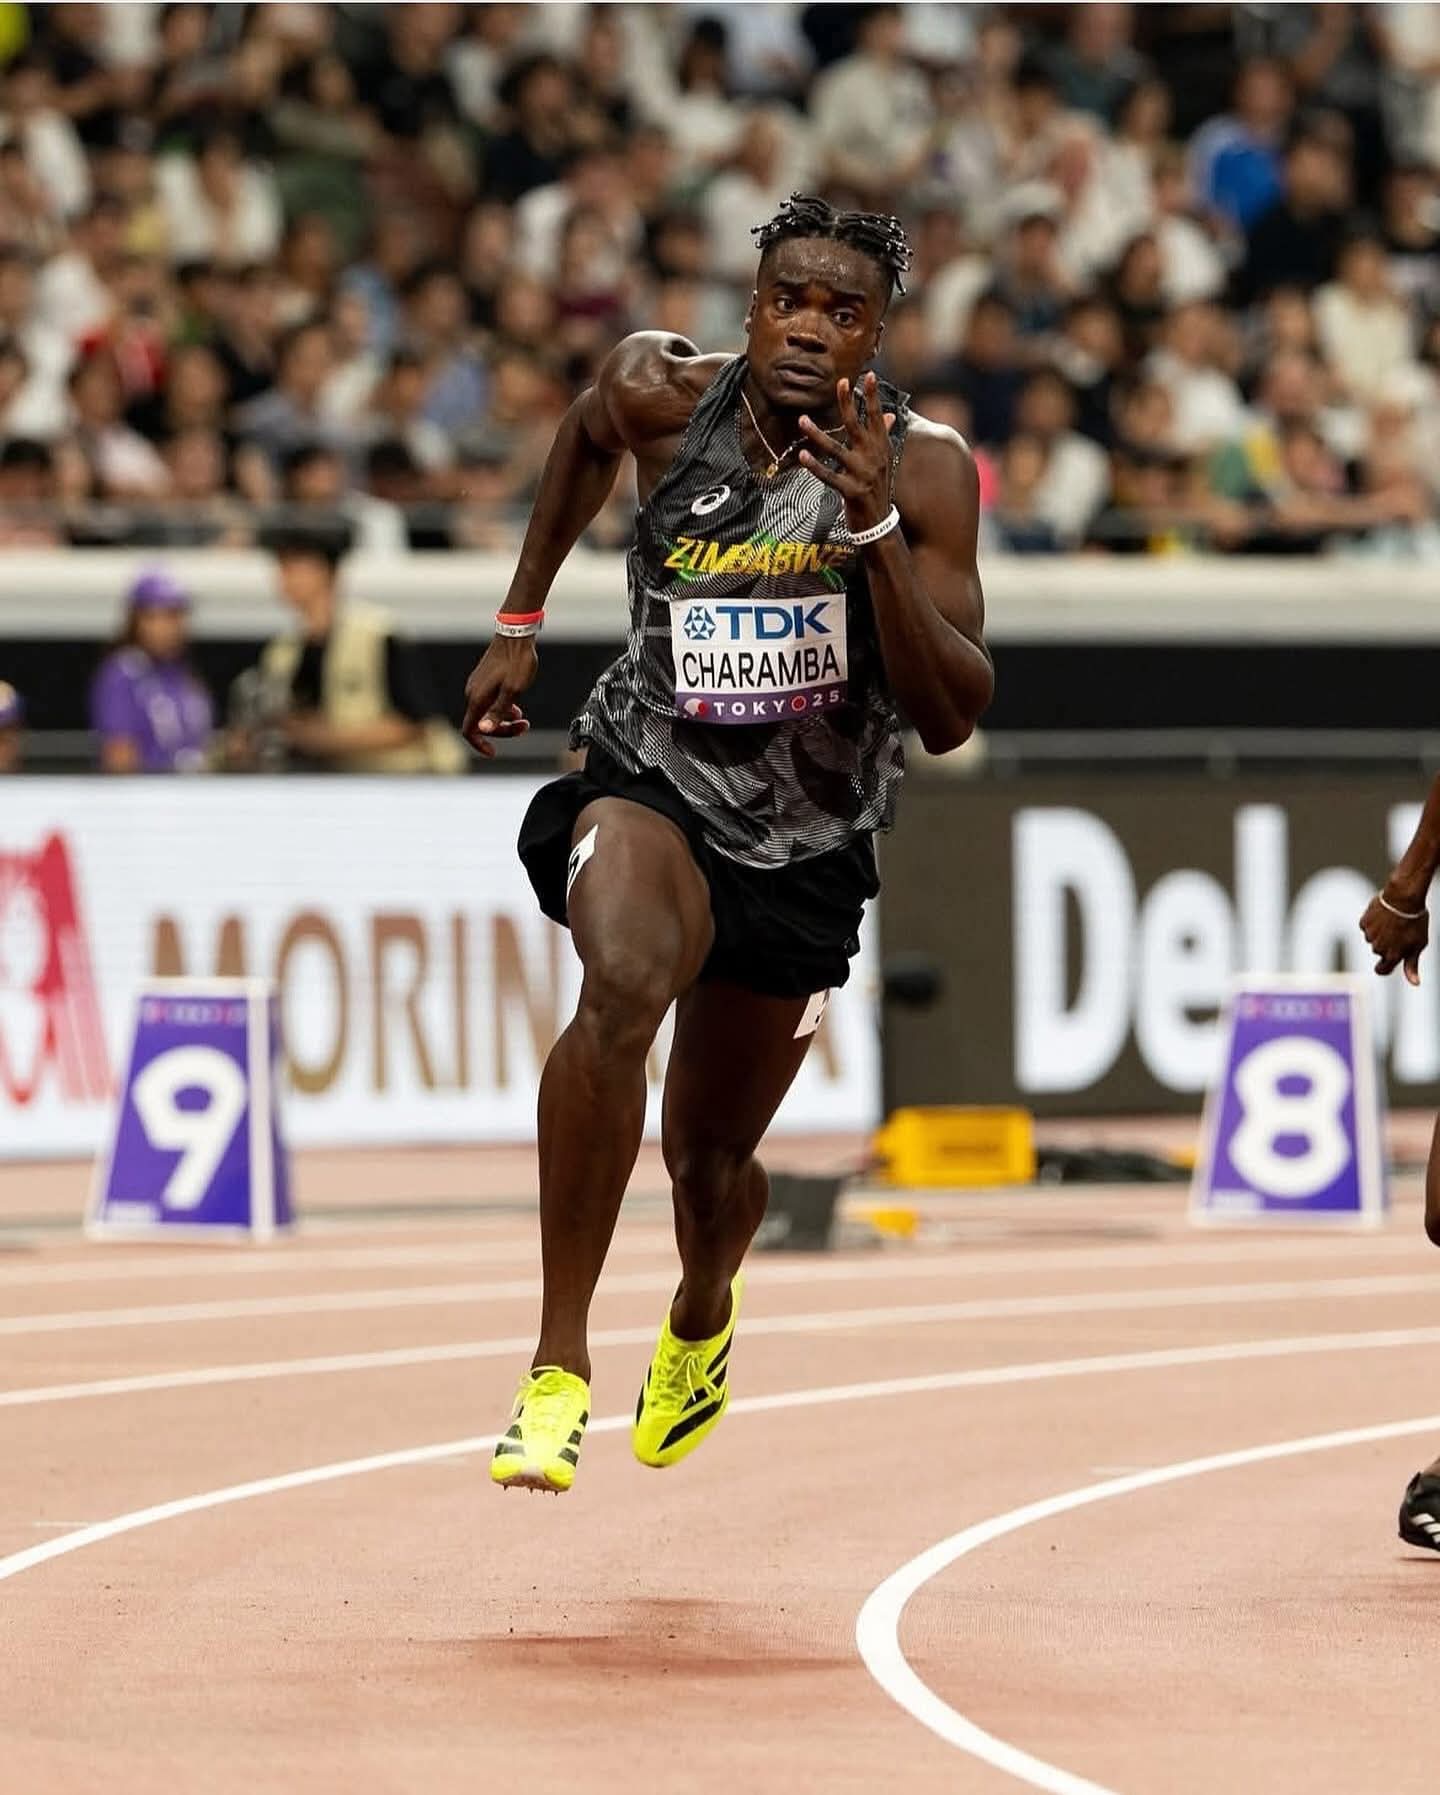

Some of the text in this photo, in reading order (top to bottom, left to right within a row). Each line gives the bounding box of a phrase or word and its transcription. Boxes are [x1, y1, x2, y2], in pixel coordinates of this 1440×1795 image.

[664, 536, 855, 576] ZIMBABWE
[715, 601, 832, 640] TDK
[682, 643, 841, 689] CHARAMBA
[133, 1044, 248, 1210] 9
[1228, 1035, 1352, 1199] 8
